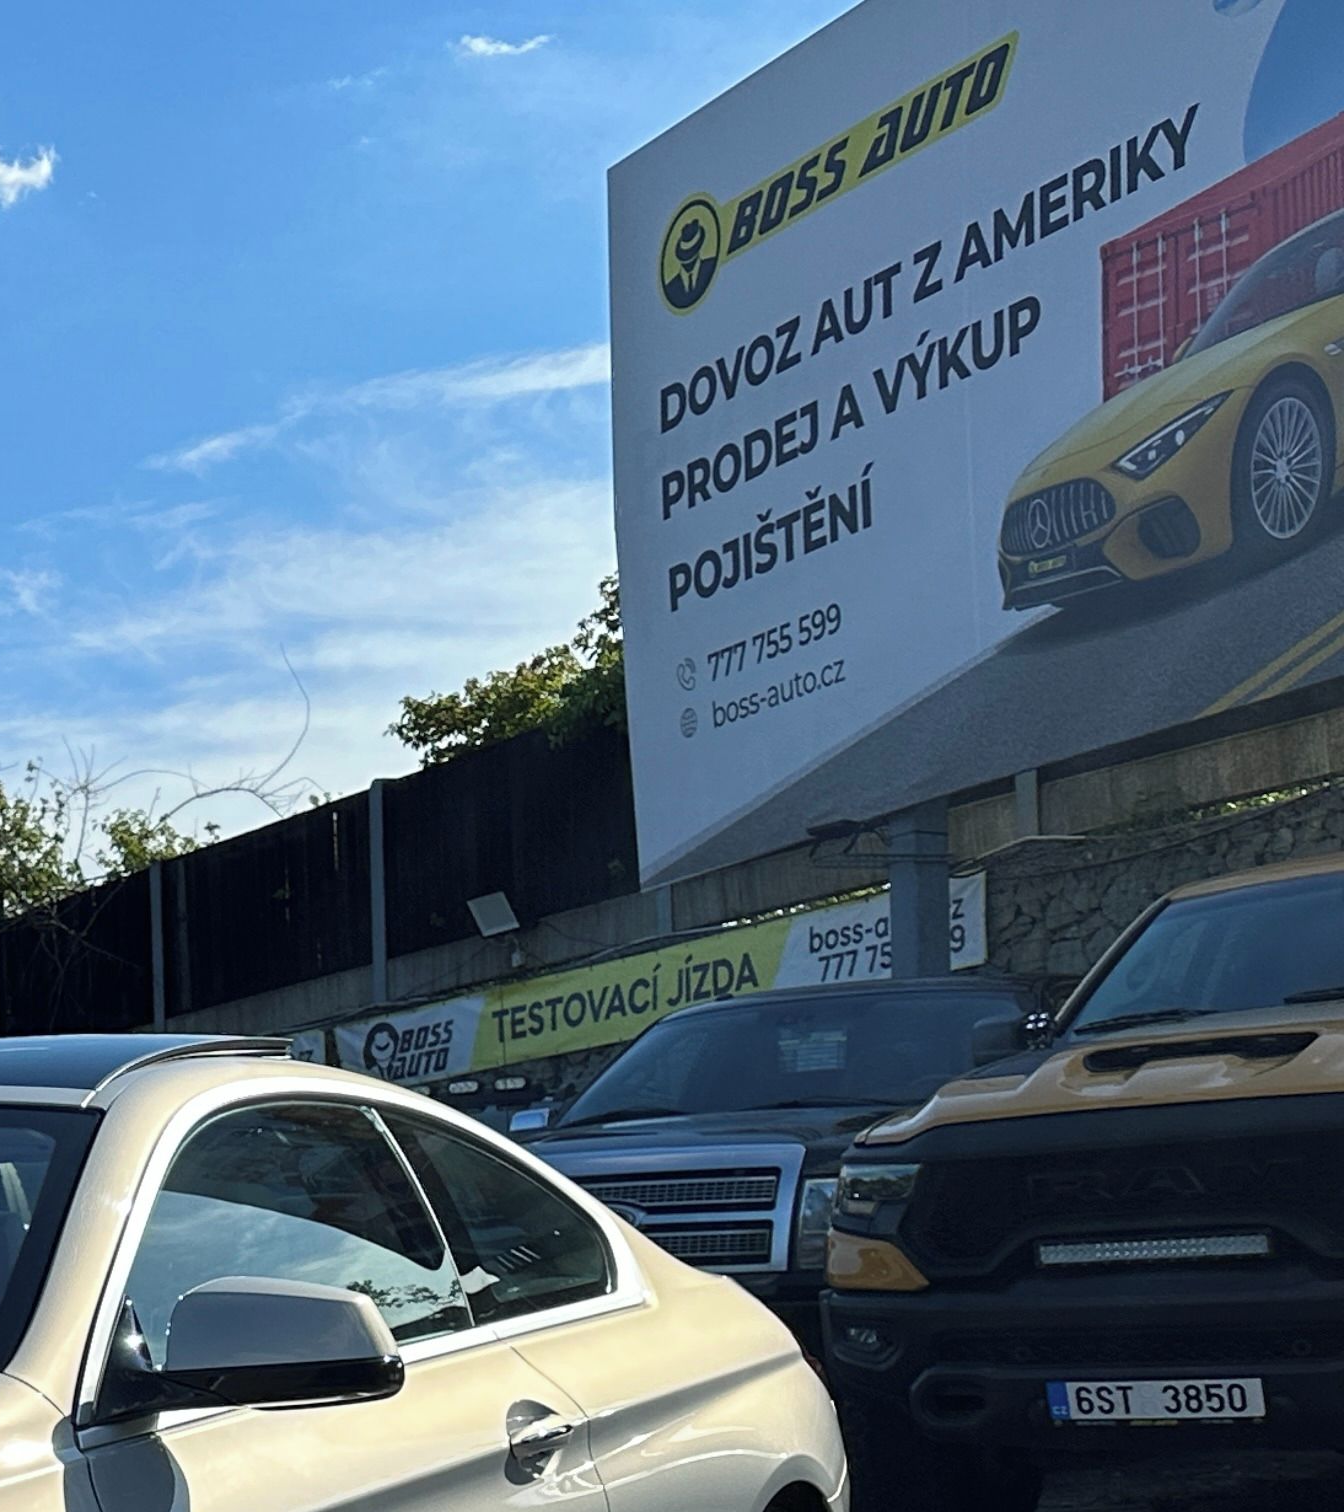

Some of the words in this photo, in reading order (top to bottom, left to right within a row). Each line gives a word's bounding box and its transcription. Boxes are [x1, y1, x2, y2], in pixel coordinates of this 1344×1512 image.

[727, 136, 850, 255] BOSS
[858, 42, 1010, 178] AUTO
[660, 315, 802, 434] DOVOZ
[812, 261, 902, 356] AUT
[913, 240, 943, 303] Z
[954, 102, 1199, 283] AMERIKY
[662, 400, 819, 521] PRODEJ
[830, 384, 865, 442] A
[872, 295, 1041, 415] VÝKUP
[669, 461, 874, 612] POJIŠTĚNÍ
[707, 640, 747, 682] 777
[752, 622, 793, 664] 755
[798, 603, 841, 646] 599
[712, 660, 846, 729] boss-auto.cz
[492, 963, 661, 1043] TESTOVACÍ
[667, 953, 759, 1007] JÍZDA
[818, 950, 858, 983] 777
[392, 1047, 450, 1080] AUTO
[400, 1019, 454, 1053] BOSS
[1075, 1386, 1133, 1415] 6ST
[1162, 1383, 1248, 1413] 3850
